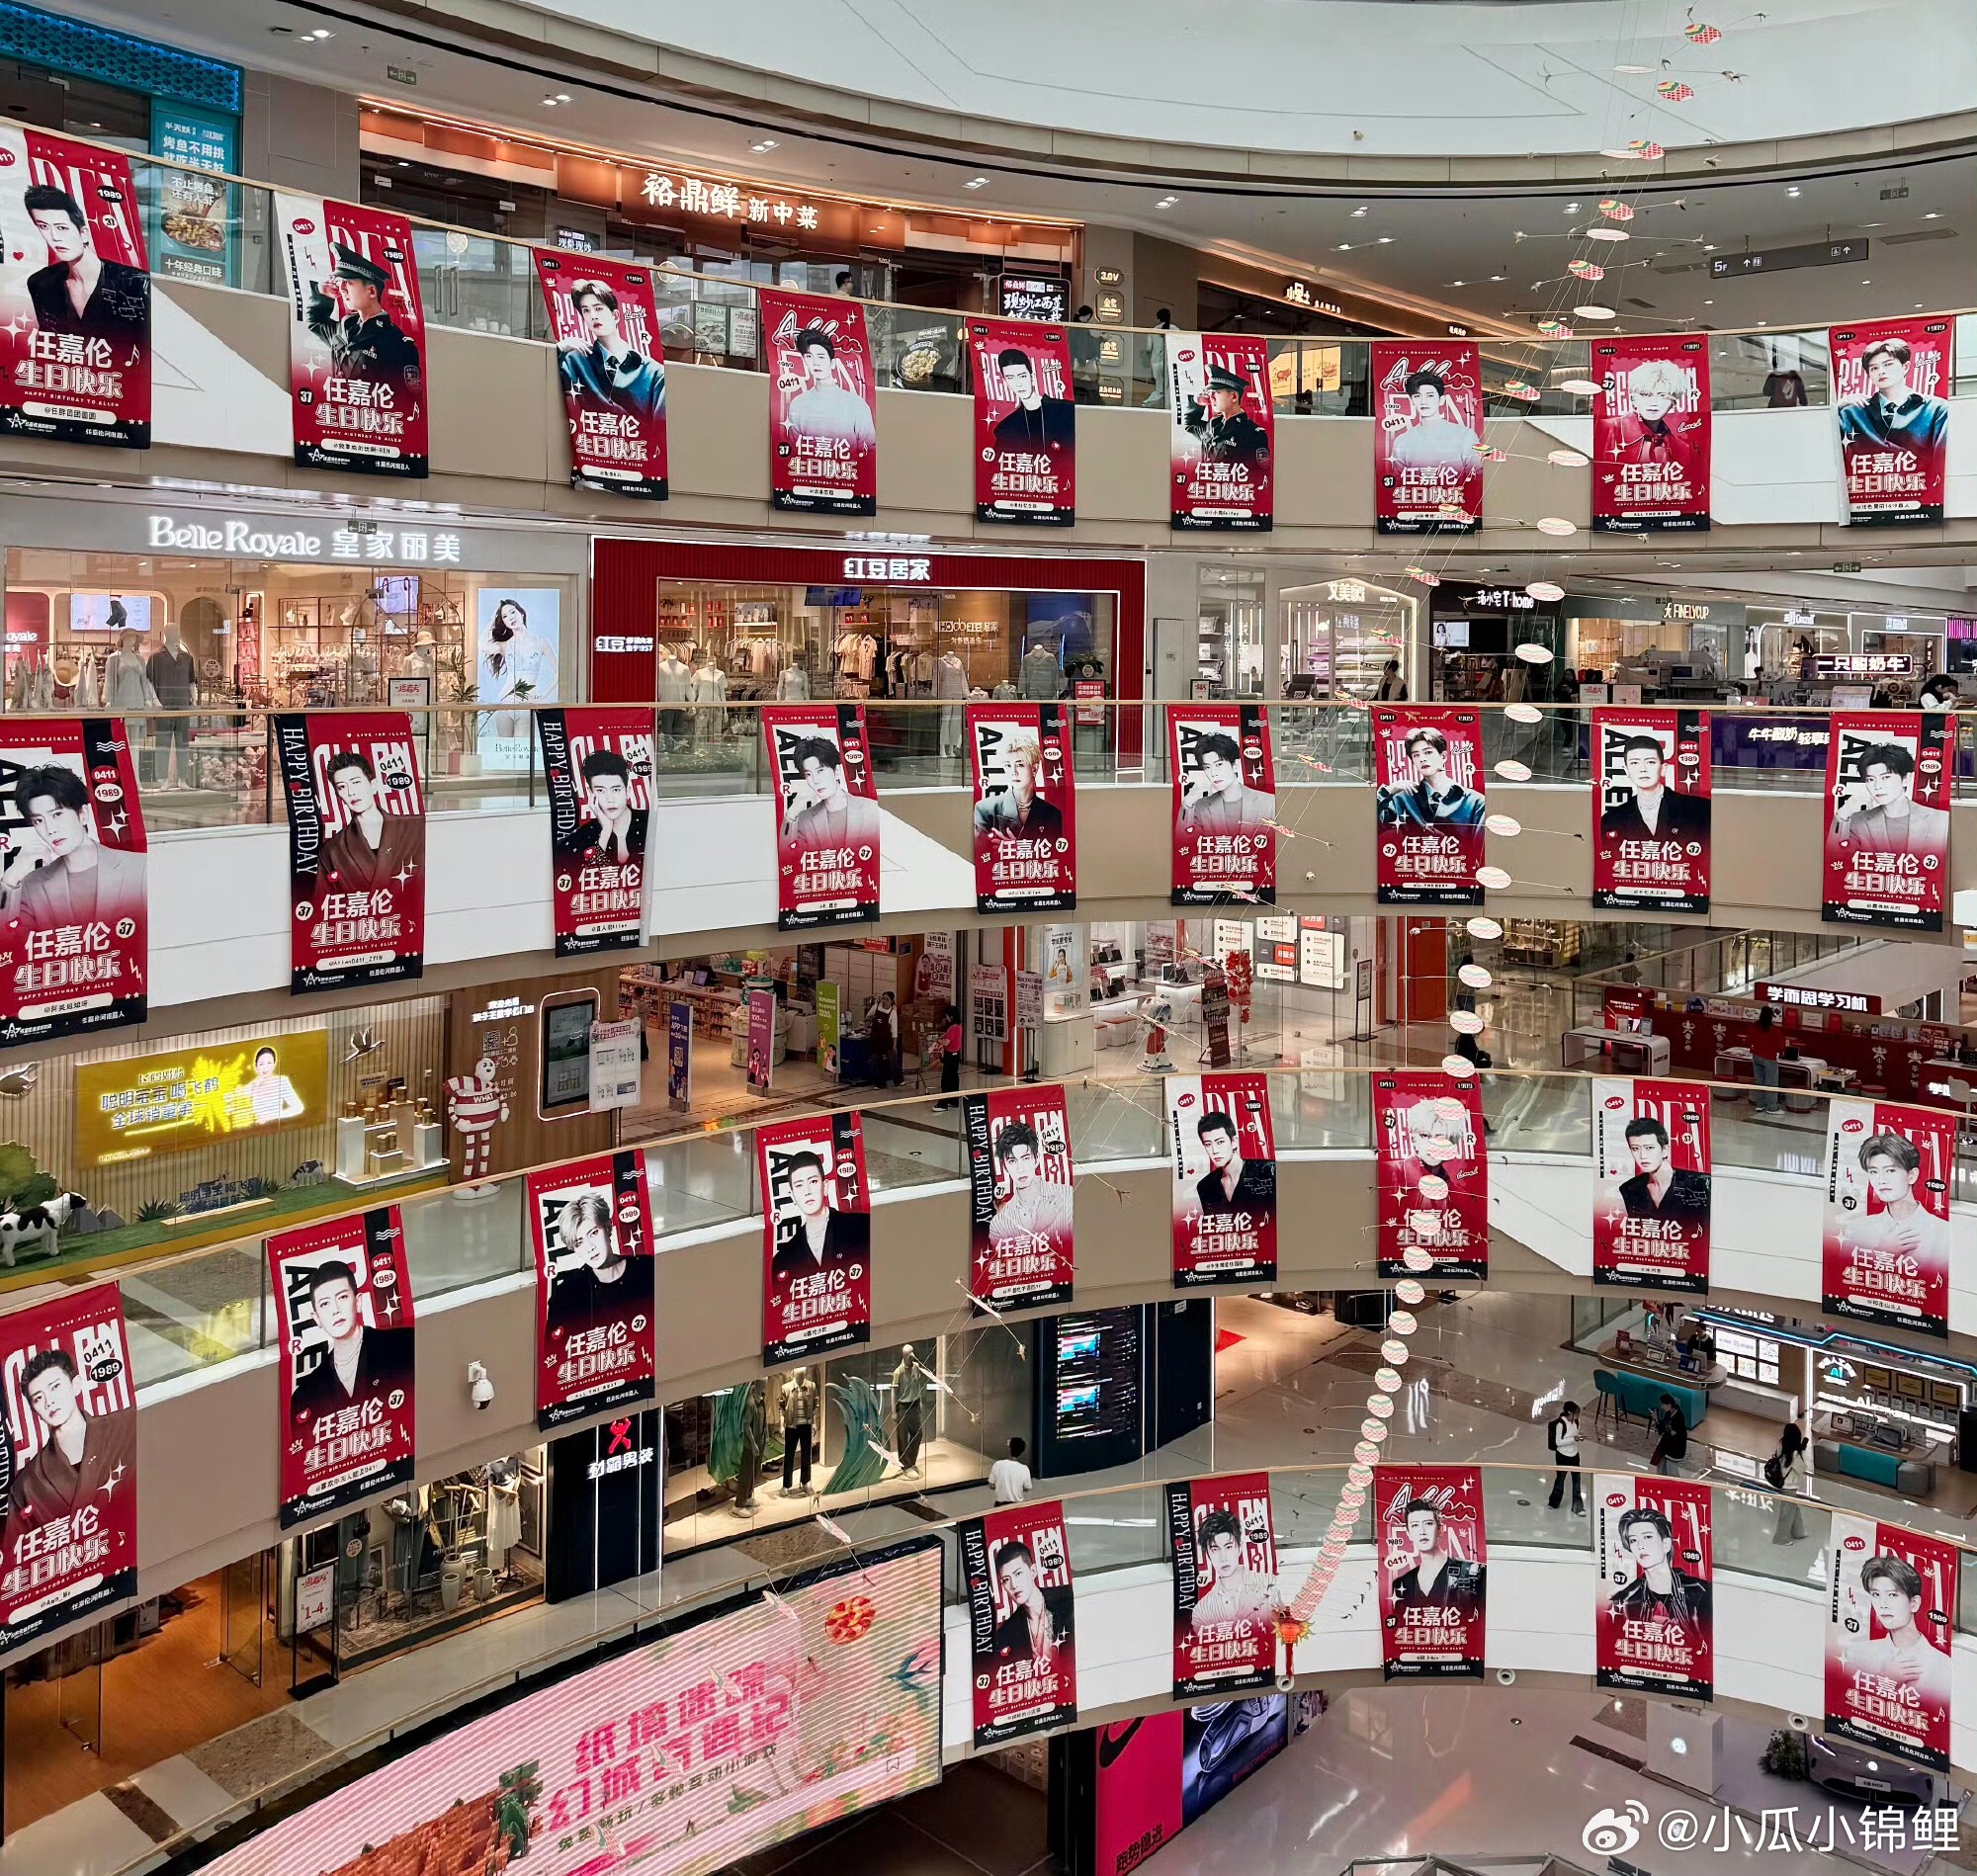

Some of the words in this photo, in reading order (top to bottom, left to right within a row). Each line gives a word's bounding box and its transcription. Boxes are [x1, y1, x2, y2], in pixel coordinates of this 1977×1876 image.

[163, 134, 225, 160] 烤鱼不用挑
[640, 173, 741, 219] 裕鼎鲜
[747, 197, 818, 231] 新中菜
[165, 259, 222, 278] 十年经典口味
[1100, 272, 1119, 281] 3.0V
[1714, 260, 1727, 272] 5F
[1003, 292, 1065, 312] 现炒江西菜
[27, 333, 113, 370] 任嘉伦
[15, 360, 123, 399] 生日快乐
[301, 390, 312, 402] 37
[323, 377, 394, 409] 任嘉伦
[316, 403, 404, 434] 生日快乐
[579, 409, 640, 439] 任嘉伦
[575, 433, 647, 461] 生日快乐
[796, 433, 851, 461] 任嘉伦
[788, 457, 858, 479] 生日快乐
[997, 452, 1052, 474] 任嘉伦
[1195, 462, 1248, 481] 任嘉伦
[1620, 462, 1684, 483] 任嘉伦
[1850, 451, 1917, 474] 任嘉伦
[991, 473, 1058, 494] 生日快乐
[1384, 476, 1395, 487] 37
[1401, 467, 1458, 486] 任嘉伦
[1847, 472, 1927, 494] 生日快乐
[1187, 482, 1255, 502] 生日快乐
[1393, 486, 1465, 504] 生日快乐
[1613, 482, 1692, 502] 生日快乐
[332, 529, 461, 561] 皇家丽美
[843, 557, 931, 581] 红豆居家
[6, 630, 38, 641] oyale
[595, 636, 626, 652] 红豆
[1818, 655, 1904, 672] 一只酸奶牛
[544, 721, 564, 767] HAPPY
[1748, 726, 1797, 741] 牛牛酸奶
[282, 727, 306, 781] HAPPY
[380, 756, 404, 772] 0411
[93, 769, 117, 782] 0411
[387, 775, 410, 786] 1989
[96, 787, 121, 800] 1989
[551, 774, 576, 841] BIRTHDA
[293, 788, 318, 874] BIRTHDAY
[860, 848, 870, 858] 37
[998, 835, 1053, 860] 任嘉伦
[1057, 840, 1067, 850] 37
[1197, 835, 1251, 853] 任嘉伦
[1402, 835, 1460, 854] 任嘉伦
[1619, 839, 1682, 860] 任嘉伦
[801, 847, 855, 871] 任嘉伦
[992, 860, 1059, 880] 生日快乐
[1190, 855, 1257, 873] 生日快乐
[1395, 855, 1467, 873] 生日快乐
[1851, 851, 1920, 874] 任嘉伦
[1924, 857, 1936, 868] 37
[578, 864, 640, 892] 任嘉伦
[794, 869, 862, 894] 生日快乐
[1613, 861, 1691, 881] 生日快乐
[1844, 871, 1926, 896] 生日快乐
[299, 905, 310, 916] 37
[321, 890, 393, 921] 任嘉伦
[570, 889, 641, 916] 生日快乐
[25, 921, 111, 958] 任嘉伦
[119, 922, 133, 935] 37
[310, 914, 402, 950] 生日快乐
[14, 950, 121, 993] 生日快乐
[1767, 985, 1868, 1011] 学而思学习机
[1208, 1015, 1227, 1028] Ultra
[473, 1093, 494, 1104] WHAT
[112, 1101, 209, 1130] 全球销量第一
[969, 1104, 990, 1150] HAPPY
[974, 1155, 992, 1224] BIRTHDAY
[1844, 1198, 1856, 1209] 37
[1197, 1213, 1252, 1234] 任嘉伦
[1620, 1217, 1683, 1239] 任嘉伦
[996, 1232, 1050, 1257] 任嘉伦
[1190, 1233, 1258, 1255] 生日快乐
[1396, 1229, 1470, 1246] 生日快乐
[1612, 1237, 1690, 1259] 生日快乐
[374, 1256, 392, 1267] 0411
[988, 1251, 1057, 1282] 生日快乐
[1851, 1245, 1919, 1277] 任嘉伦
[375, 1272, 393, 1285] 1989
[790, 1269, 845, 1298] 任嘉伦
[1843, 1268, 1927, 1299] 生日快乐
[782, 1288, 853, 1324] 生日快乐
[565, 1322, 628, 1355] 任嘉伦
[92, 1363, 120, 1380] 1989
[558, 1341, 636, 1384] 生日快乐
[388, 1393, 404, 1405] 37
[313, 1400, 383, 1444] 任嘉伦
[304, 1420, 392, 1473] 生日快乐
[587, 1448, 654, 1481] 劲霸男装
[1171, 1492, 1192, 1538] HAPPY
[14, 1503, 100, 1564] 任嘉伦
[1, 1529, 111, 1600] 生日快乐
[965, 1529, 988, 1578] HAPPY
[1387, 1554, 1408, 1567] 0411
[1176, 1543, 1195, 1611] BIRTHDAY
[1614, 1574, 1626, 1583] 37
[970, 1580, 992, 1654] BIRTHDAY
[1387, 1618, 1396, 1627] 37
[1404, 1606, 1461, 1627] 任嘉伦
[1197, 1619, 1252, 1645] 任嘉伦
[1395, 1627, 1467, 1646] 生日快乐
[1623, 1620, 1684, 1647] 任嘉伦
[1190, 1638, 1258, 1663] 生日快乐
[1614, 1639, 1693, 1665] 生日快乐
[996, 1656, 1052, 1686] 任嘉伦
[988, 1677, 1058, 1709] 生日快乐
[1852, 1669, 1921, 1707] 任嘉伦
[1846, 1689, 1930, 1731] 生日快乐
